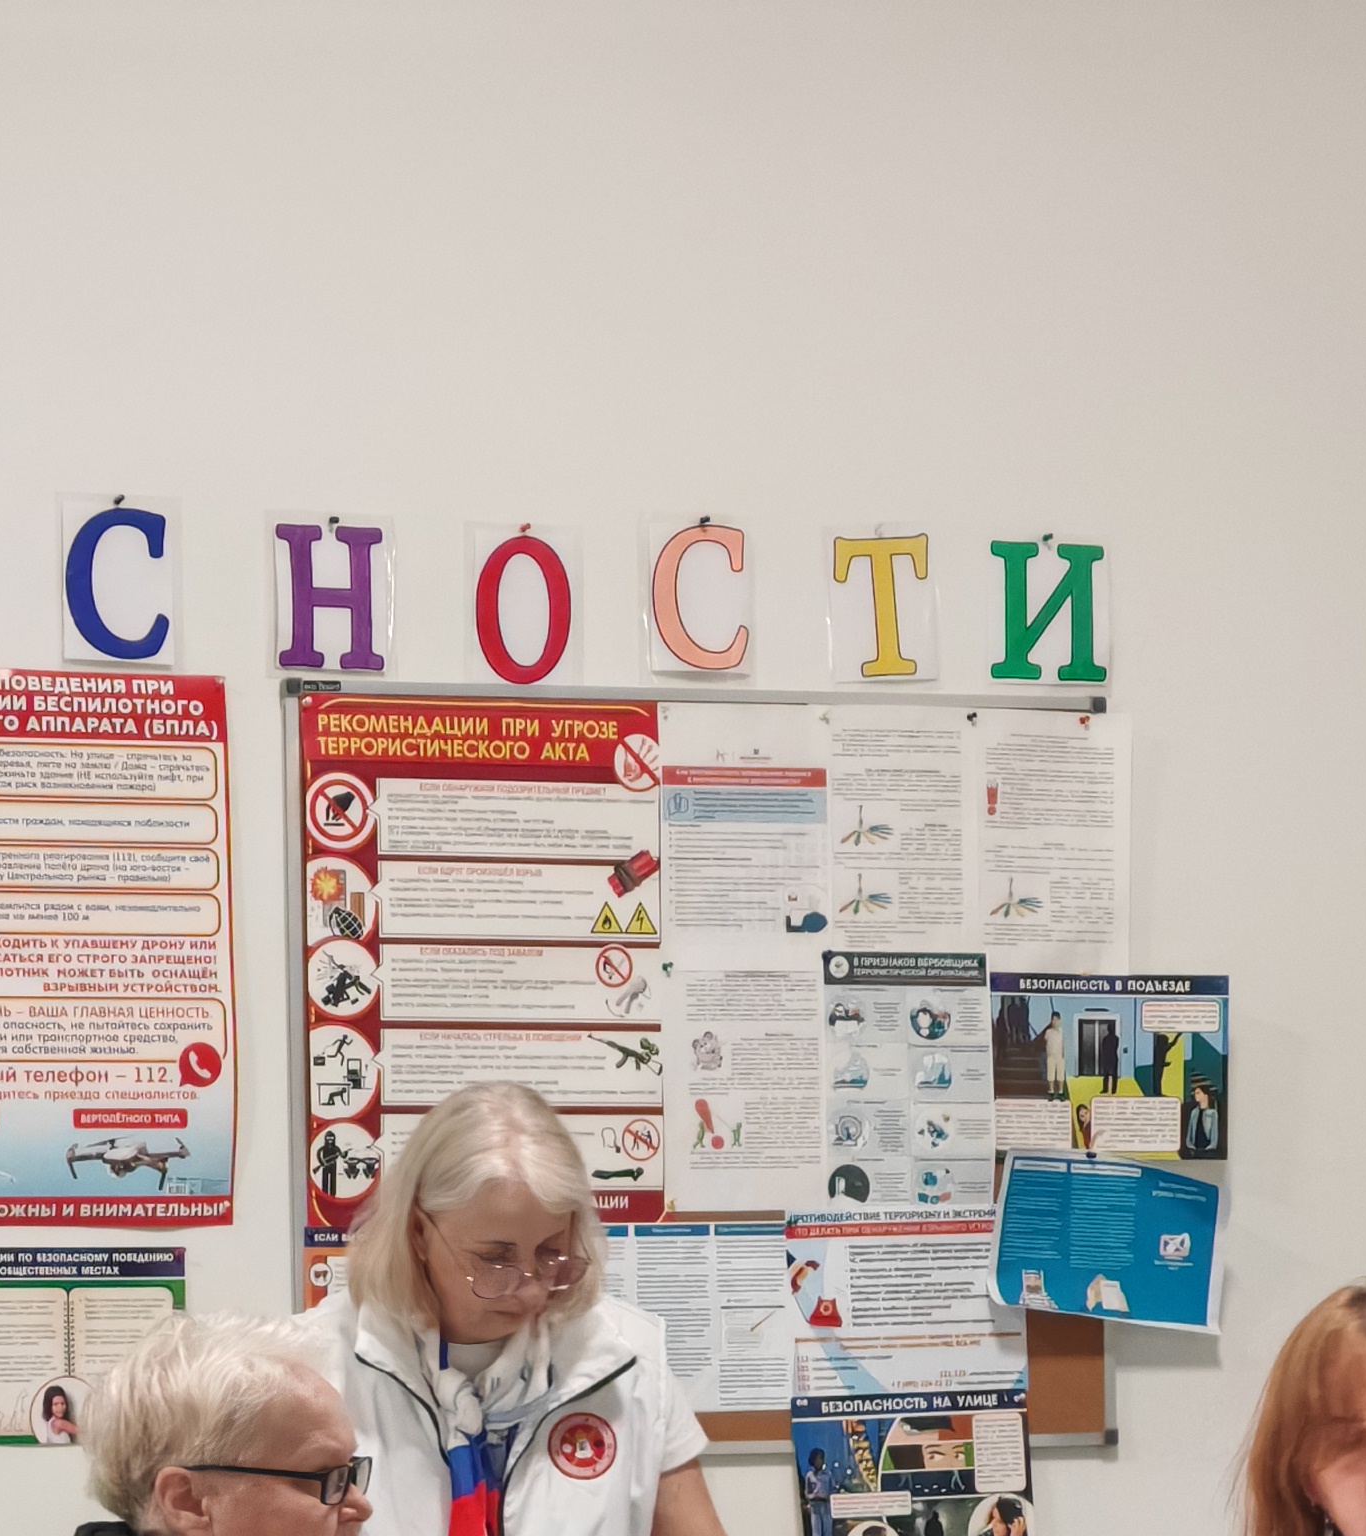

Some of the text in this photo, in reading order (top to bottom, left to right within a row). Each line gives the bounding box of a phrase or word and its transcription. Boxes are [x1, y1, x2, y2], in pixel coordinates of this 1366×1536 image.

[131, 678, 174, 695] ПРИ
[33, 695, 203, 716] БЕСПИЛОТНОГО
[26, 715, 138, 734] АППАРАТА
[144, 719, 217, 740] (БПЛА)
[318, 713, 618, 739] РЕКОМЕНДАЦИИ ПРИ УГРОЗЕ
[317, 736, 589, 761] ТЕРРОРИСТИЧЕСКОГО АКТА
[50, 938, 58, 948] К
[63, 939, 137, 949] УПАВШЕМУ
[140, 939, 185, 951] ДРОНУ
[189, 940, 216, 950] ИЛИ
[47, 953, 72, 963] ЕГО
[76, 953, 127, 964] СТРОГО
[131, 954, 216, 965] ЗАПРЕЩЕНО!
[56, 968, 105, 978] МОЖЕТ
[108, 968, 144, 978] БЫТЬ
[151, 967, 217, 982] ОСНАЩЁН
[42, 981, 221, 993] ВЗРЫВНЫМ УСТРОЙСТВОМ.
[1019, 978, 1190, 993] БЕЗОПАСНОСТЬ В ПОДЪЕЗДЕ
[28, 1005, 68, 1017] ВАША
[73, 1005, 134, 1018] ГЛАВНАЯ
[138, 1006, 213, 1019] ЦЕННОСТЬ.
[24, 1065, 108, 1087] телефон
[134, 1066, 172, 1083] 112.
[61, 1203, 74, 1216] И
[821, 1393, 998, 1413] БЕЗОПАСНОСТЬ НА УЛИЦЕ
